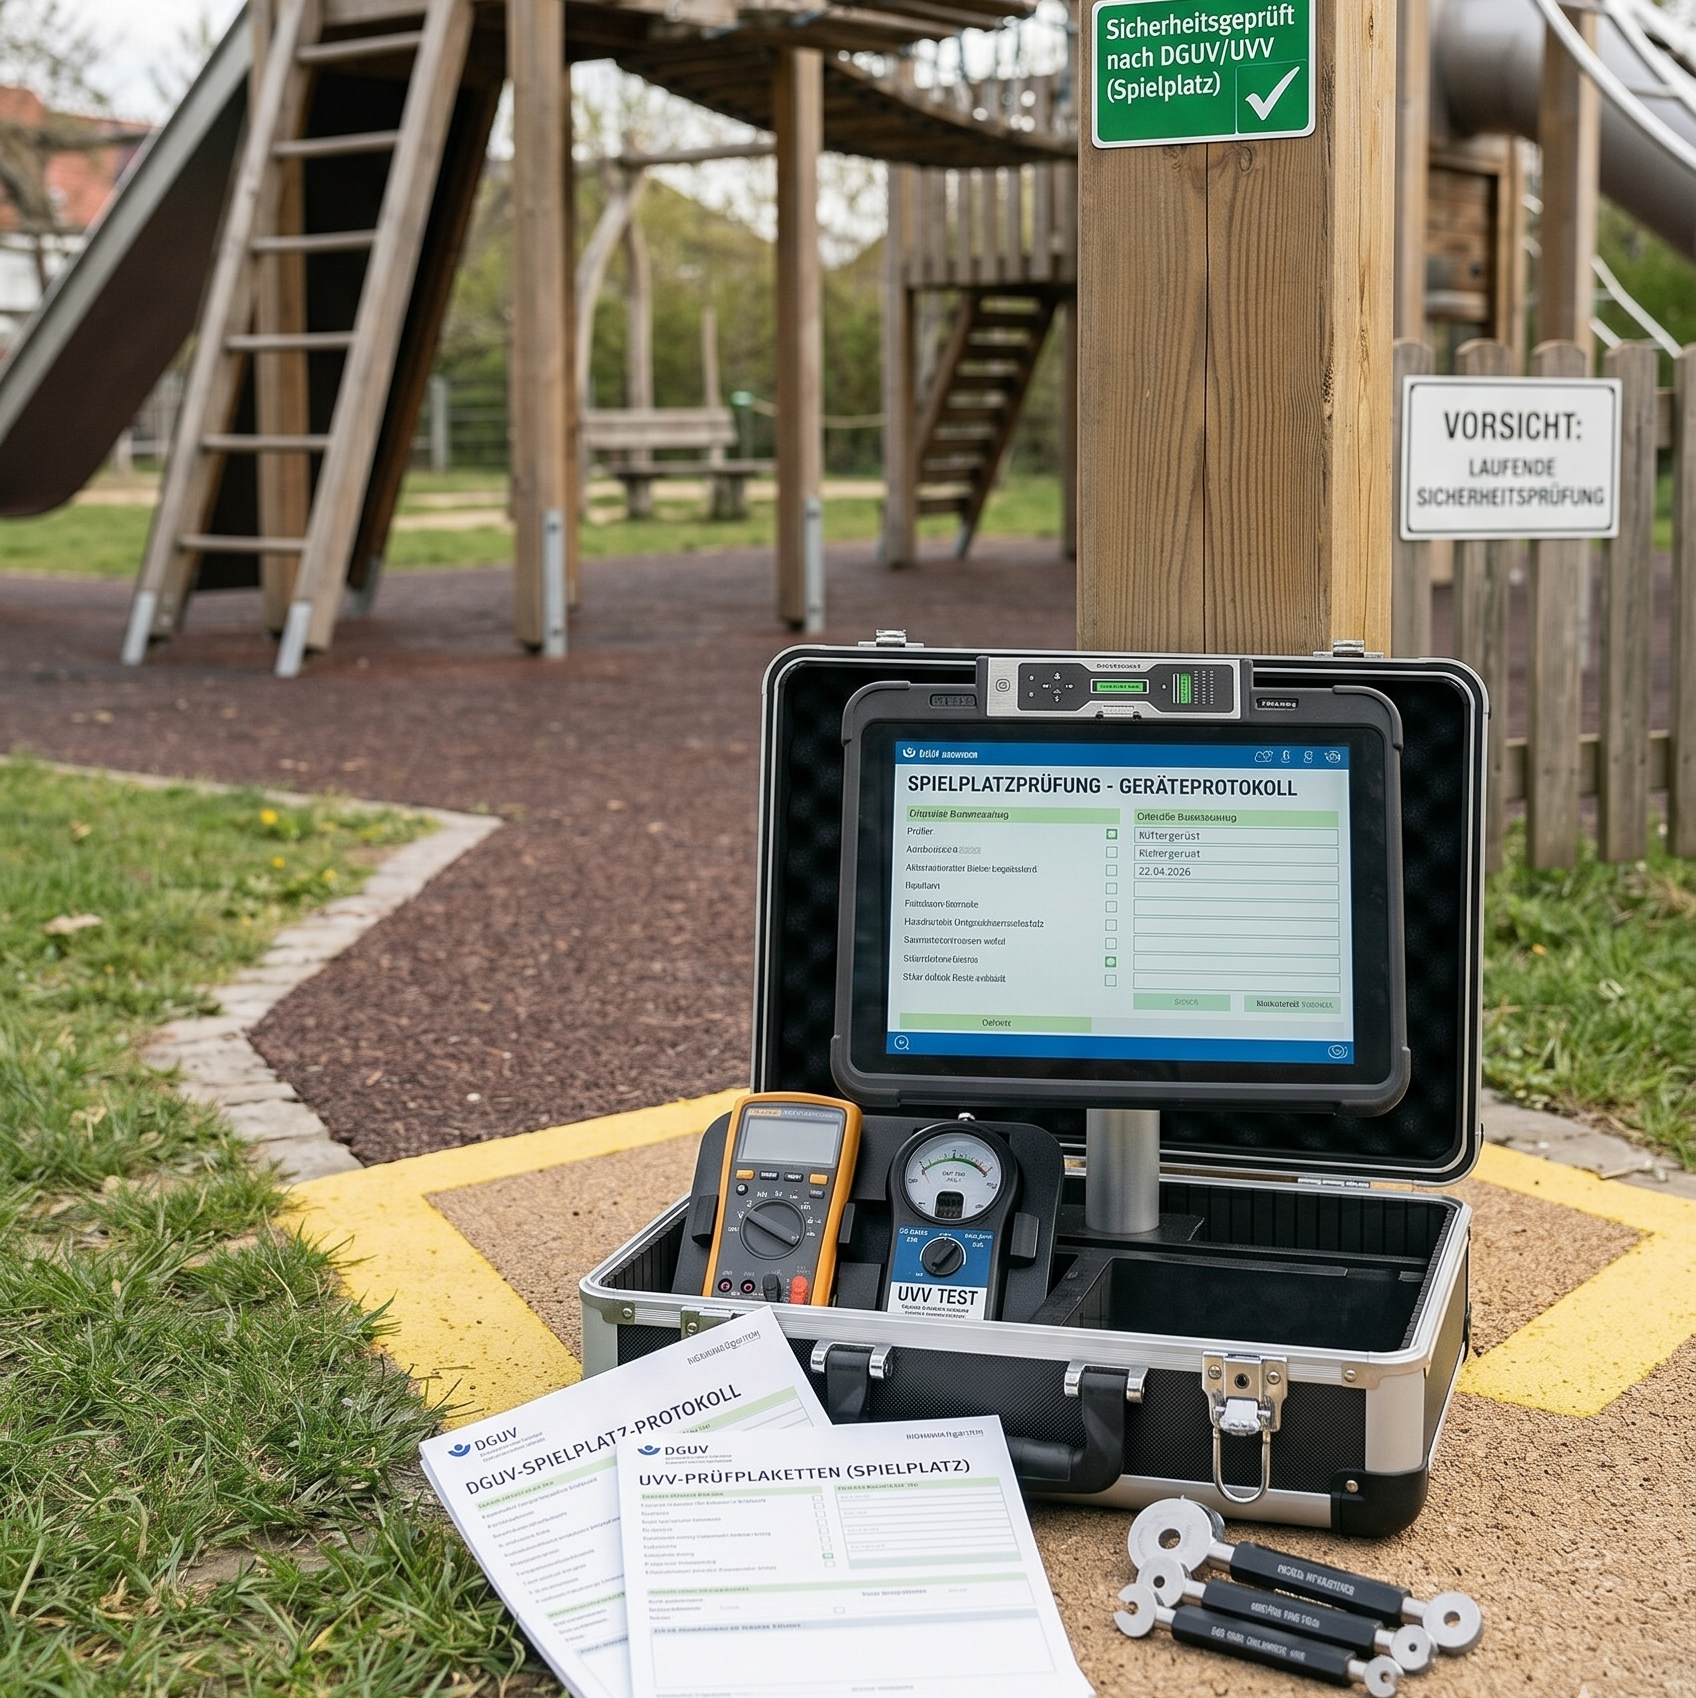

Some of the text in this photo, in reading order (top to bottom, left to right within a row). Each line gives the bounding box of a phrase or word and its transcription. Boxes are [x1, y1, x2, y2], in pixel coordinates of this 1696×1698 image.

[1106, 3, 1295, 40] Sicherheitsgeprüft
[1107, 37, 1275, 70] nach DGUV/UVV
[1106, 71, 1221, 104] (Spielplatz)
[1444, 410, 1582, 441] VORSICHT:
[1468, 457, 1557, 478] LAUFENDE
[1416, 482, 1605, 507] SICHERHEITSPRÜFUNG
[907, 773, 1101, 794] SPIELPLATZPRÜFUNG
[1119, 775, 1298, 796] GERÄTEPROTOKOLL
[1138, 866, 1191, 877] 22.04.2026
[897, 1285, 979, 1306] UVV TEST
[474, 1426, 518, 1451] DGUV
[664, 1445, 709, 1456] DGUV
[639, 1458, 971, 1486] UVV-PRÜFPLAKETTEN (SPIELPLATZ)
